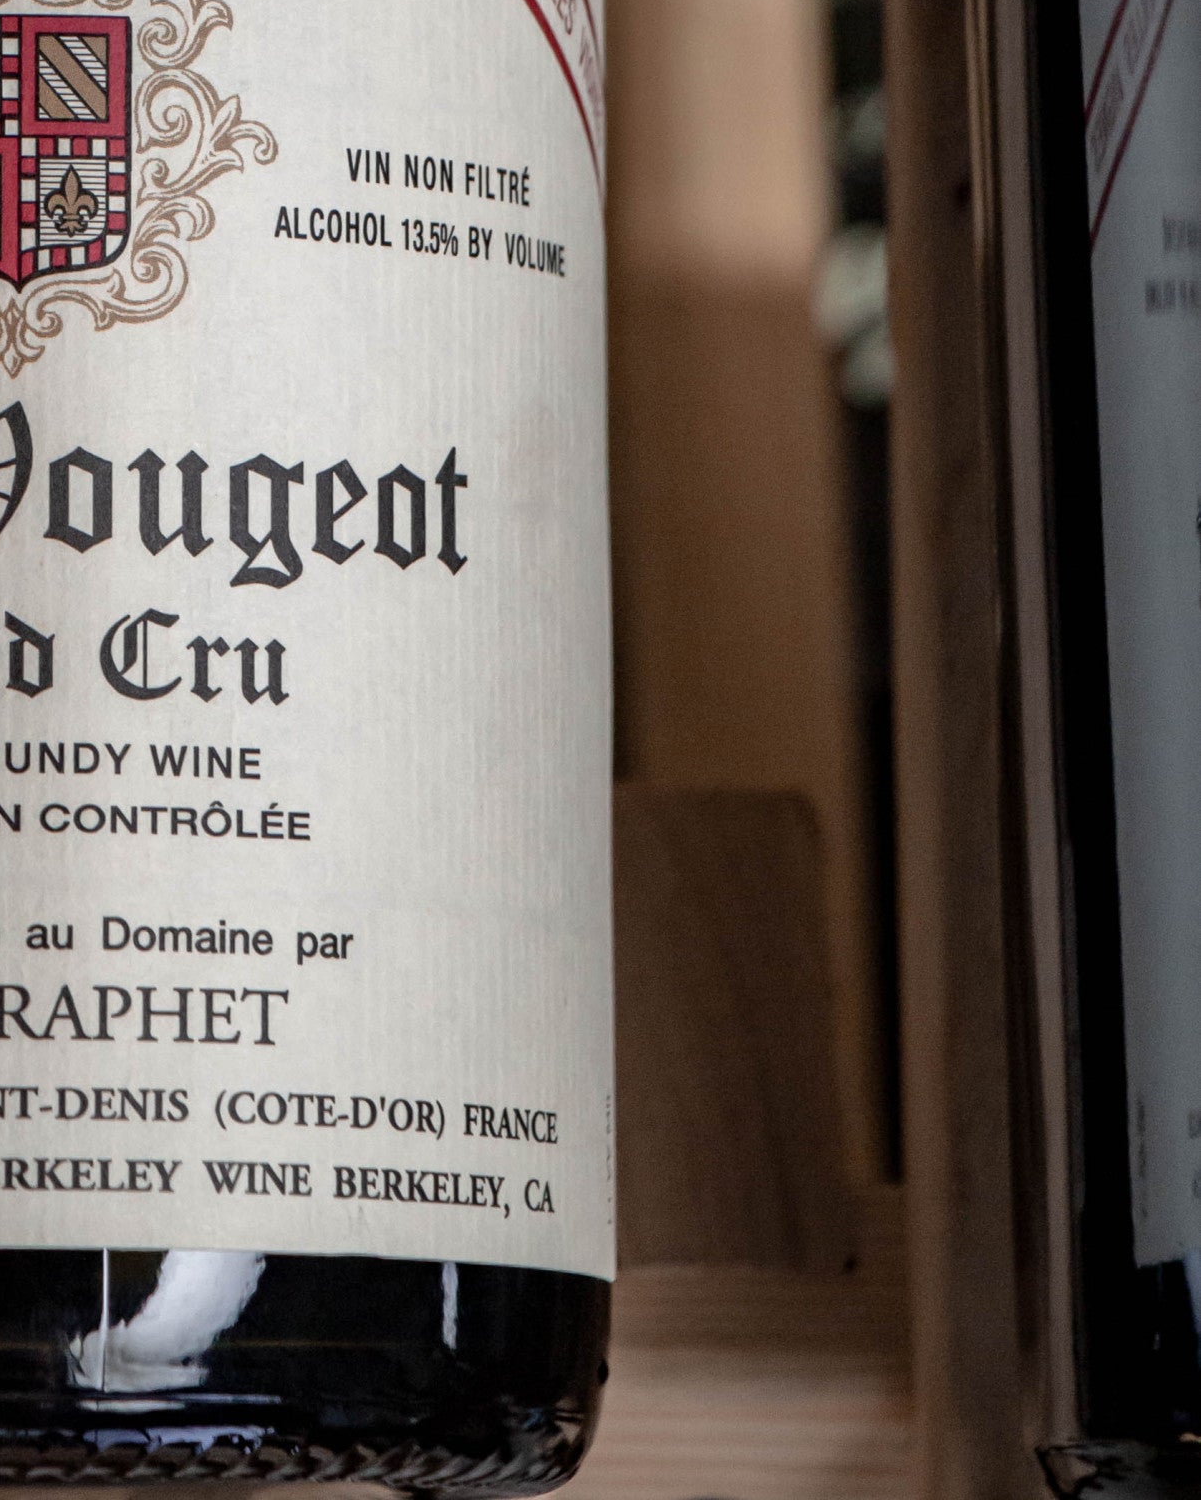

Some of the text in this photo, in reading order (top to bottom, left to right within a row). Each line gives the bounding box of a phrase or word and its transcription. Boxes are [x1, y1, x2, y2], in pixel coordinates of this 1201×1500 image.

[346, 147, 530, 208] VIN NON FILTRÉ
[273, 205, 566, 278] ALCOHOL 13.5% BY VOLUME
[98, 607, 290, 707] Cru
[149, 744, 262, 781] WINE
[39, 800, 311, 842] CONTRÔLÉE
[25, 923, 74, 951] au
[102, 915, 274, 956] Domaine
[296, 931, 355, 966] par
[214, 1090, 446, 1141] (COTE-D'OR)
[463, 1103, 559, 1145] FRANCE
[202, 1160, 313, 1197] WINE
[333, 1166, 511, 1219] BERKELEY,
[523, 1178, 556, 1214] CA
